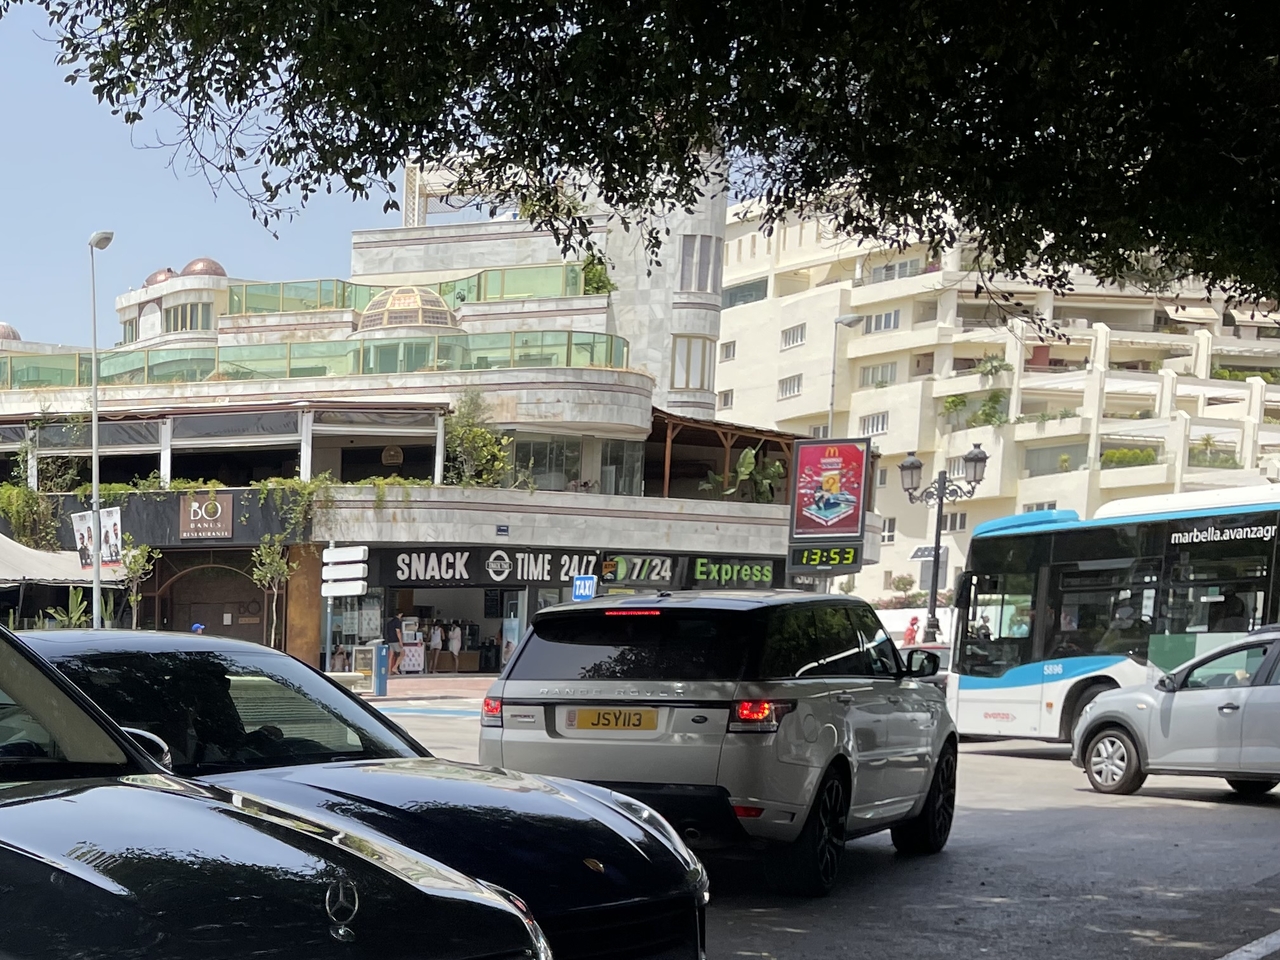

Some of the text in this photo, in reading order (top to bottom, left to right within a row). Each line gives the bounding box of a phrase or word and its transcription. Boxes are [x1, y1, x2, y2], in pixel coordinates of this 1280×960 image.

[1171, 525, 1277, 544] marbella.avanzagr
[802, 548, 854, 564] 13:53
[396, 552, 597, 581] SNACK TIME 24/7
[631, 558, 671, 581] 7/24
[694, 558, 773, 586] Express
[575, 580, 593, 596] TAXI
[1043, 664, 1064, 675] 5896
[614, 687, 685, 697] ROVER
